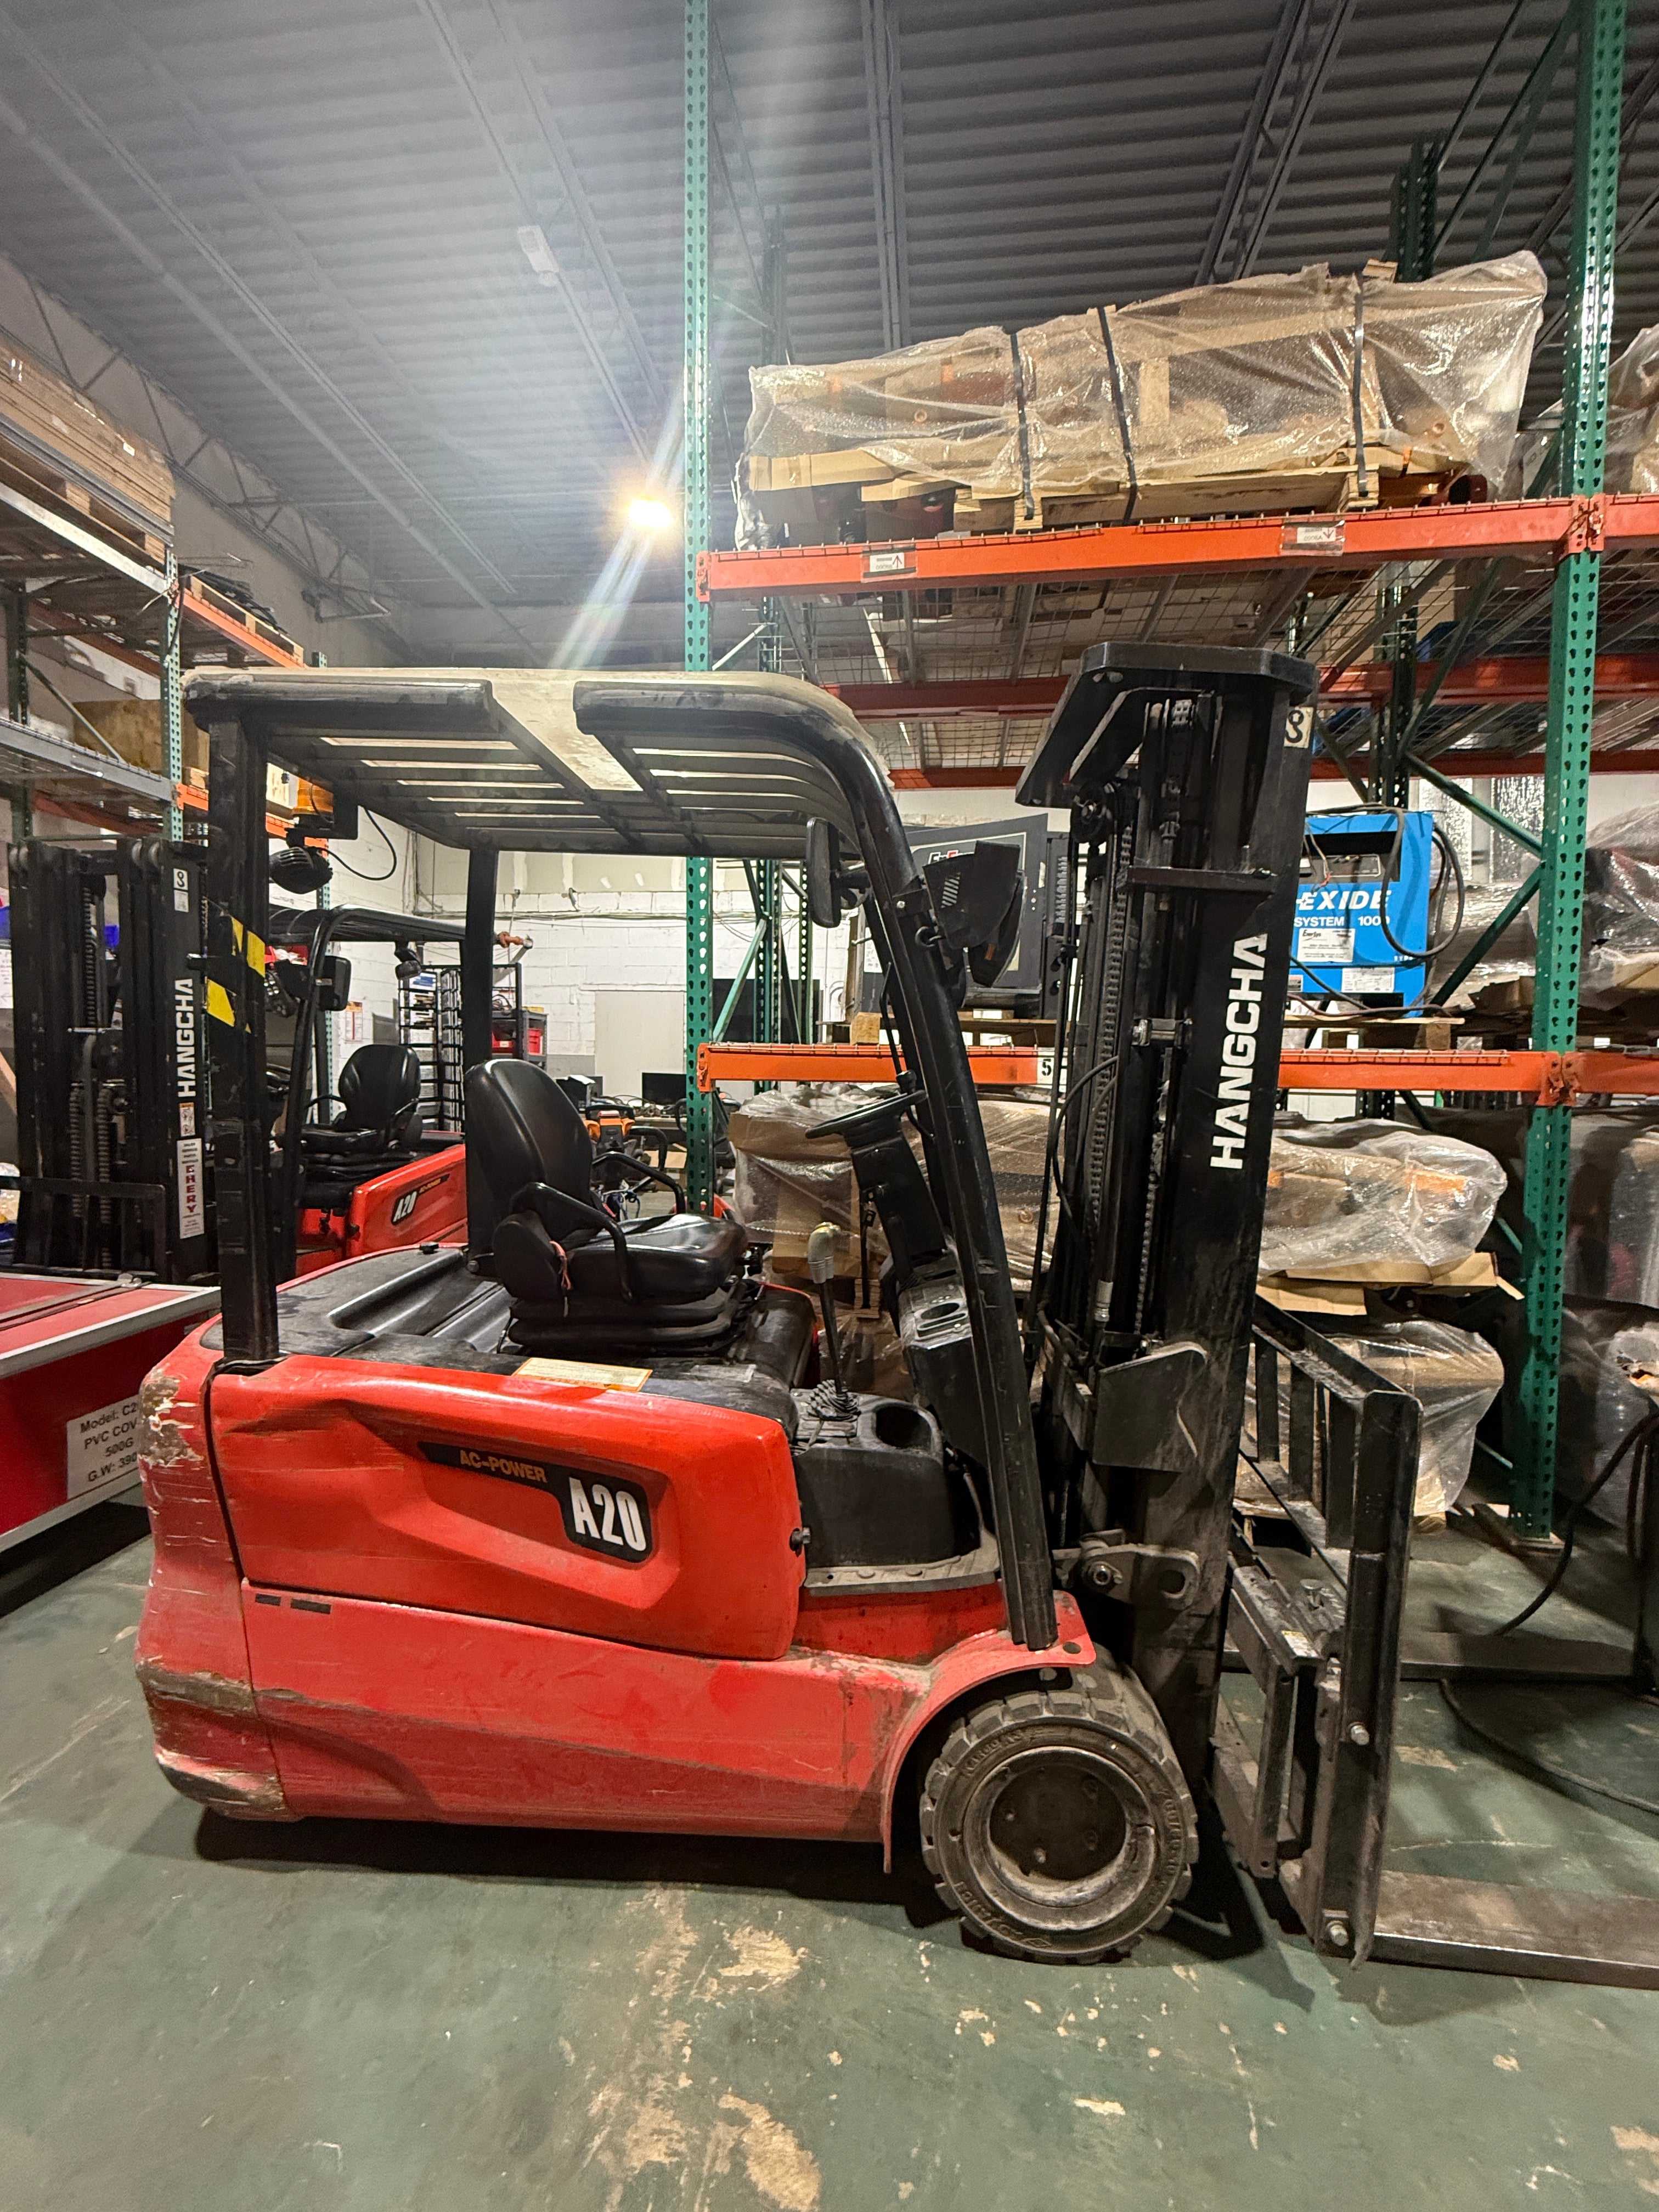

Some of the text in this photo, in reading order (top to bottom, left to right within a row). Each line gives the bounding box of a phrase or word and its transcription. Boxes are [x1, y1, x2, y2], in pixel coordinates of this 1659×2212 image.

[1296, 890, 1392, 910] EXIDE
[1294, 916, 1344, 927] SYSTEM
[174, 979, 196, 1097] HANGCHA
[1210, 933, 1268, 1169] HANGCHA
[1042, 1058, 1052, 1076] 5
[393, 1191, 417, 1222] A20
[84, 1431, 109, 1449] PVC
[460, 1450, 548, 1482] AC-POWER
[569, 1477, 646, 1551] A20
